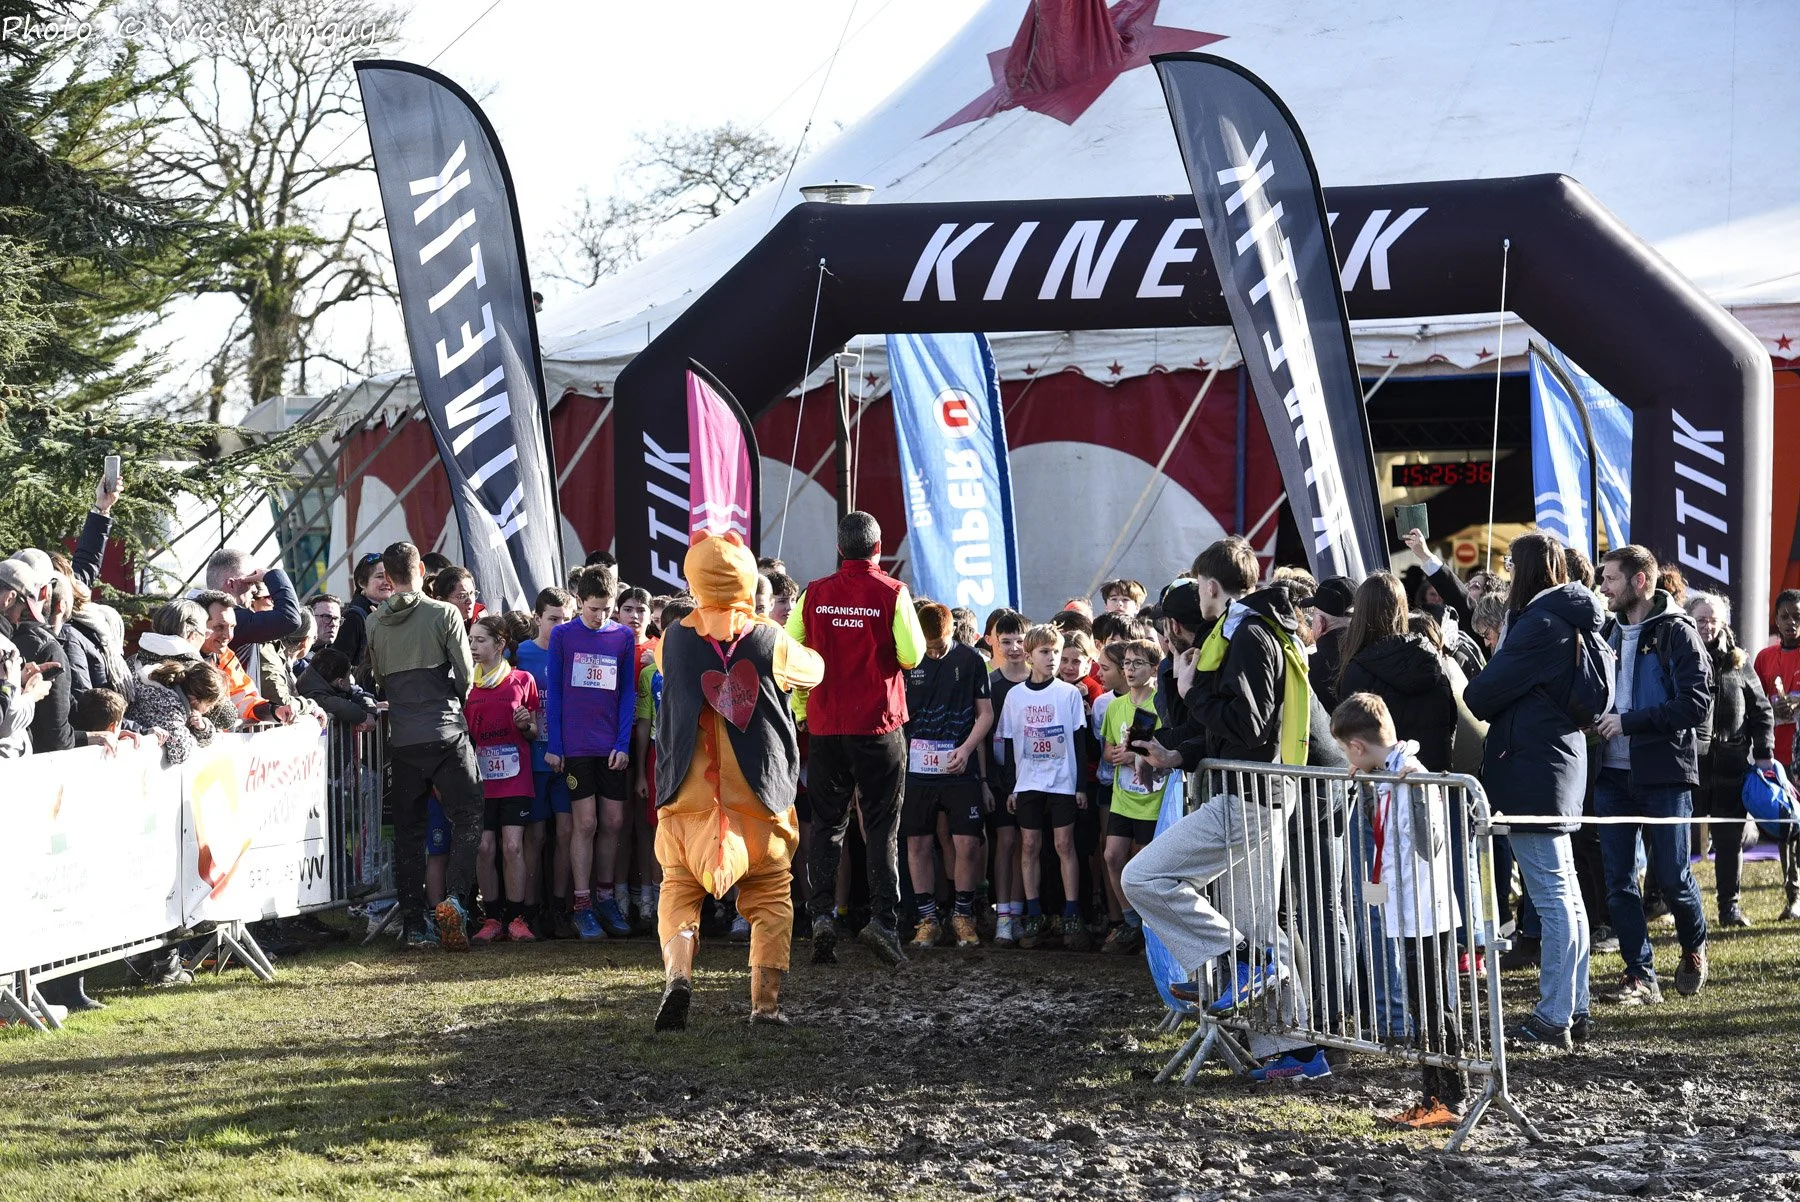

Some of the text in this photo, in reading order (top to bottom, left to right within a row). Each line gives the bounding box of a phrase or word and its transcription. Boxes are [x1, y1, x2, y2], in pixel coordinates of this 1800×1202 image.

[903, 207, 1430, 302] KINEK
[1402, 463, 1492, 486] 15:26:36
[1672, 408, 1730, 595] ETIK
[815, 605, 880, 618] ORGANISATION
[832, 618, 864, 628] GLAZIG
[587, 668, 603, 681] 318
[1028, 705, 1050, 713] TRAIL
[1027, 715, 1052, 724] GLAZIG
[480, 728, 509, 740] RENNES
[1033, 741, 1051, 753] 289
[488, 760, 505, 772] 341
[923, 754, 939, 766] 314
[1266, 1066, 1304, 1079] BROOKS
